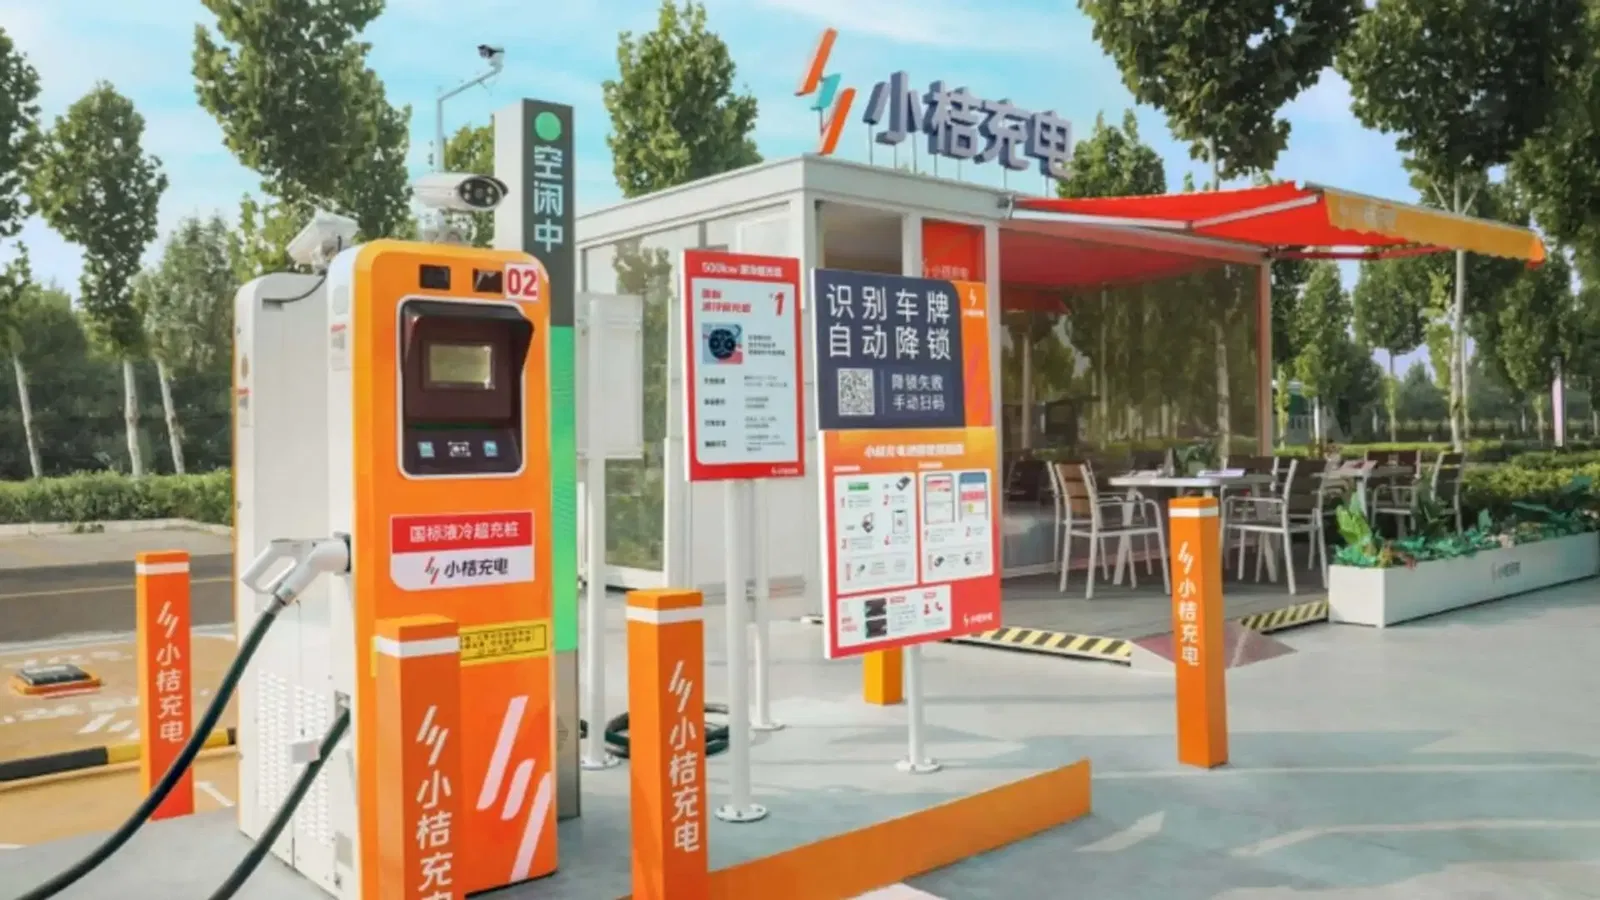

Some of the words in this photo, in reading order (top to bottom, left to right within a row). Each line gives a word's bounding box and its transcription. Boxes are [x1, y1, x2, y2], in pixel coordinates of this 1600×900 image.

[862, 70, 1074, 182] 小桔充电
[533, 145, 564, 253] 空闲中
[507, 268, 537, 297] 02
[826, 284, 951, 325] 识别车牌
[829, 323, 951, 361] 自动降锁
[891, 373, 944, 392] 降锁失败
[892, 394, 946, 412] 手动扫码
[444, 557, 508, 578] 小桔充电
[1177, 577, 1200, 668] 小桔充电
[156, 642, 185, 744] 小桔充电
[668, 715, 701, 853] 小桔充电
[415, 769, 453, 900] 小桔充
